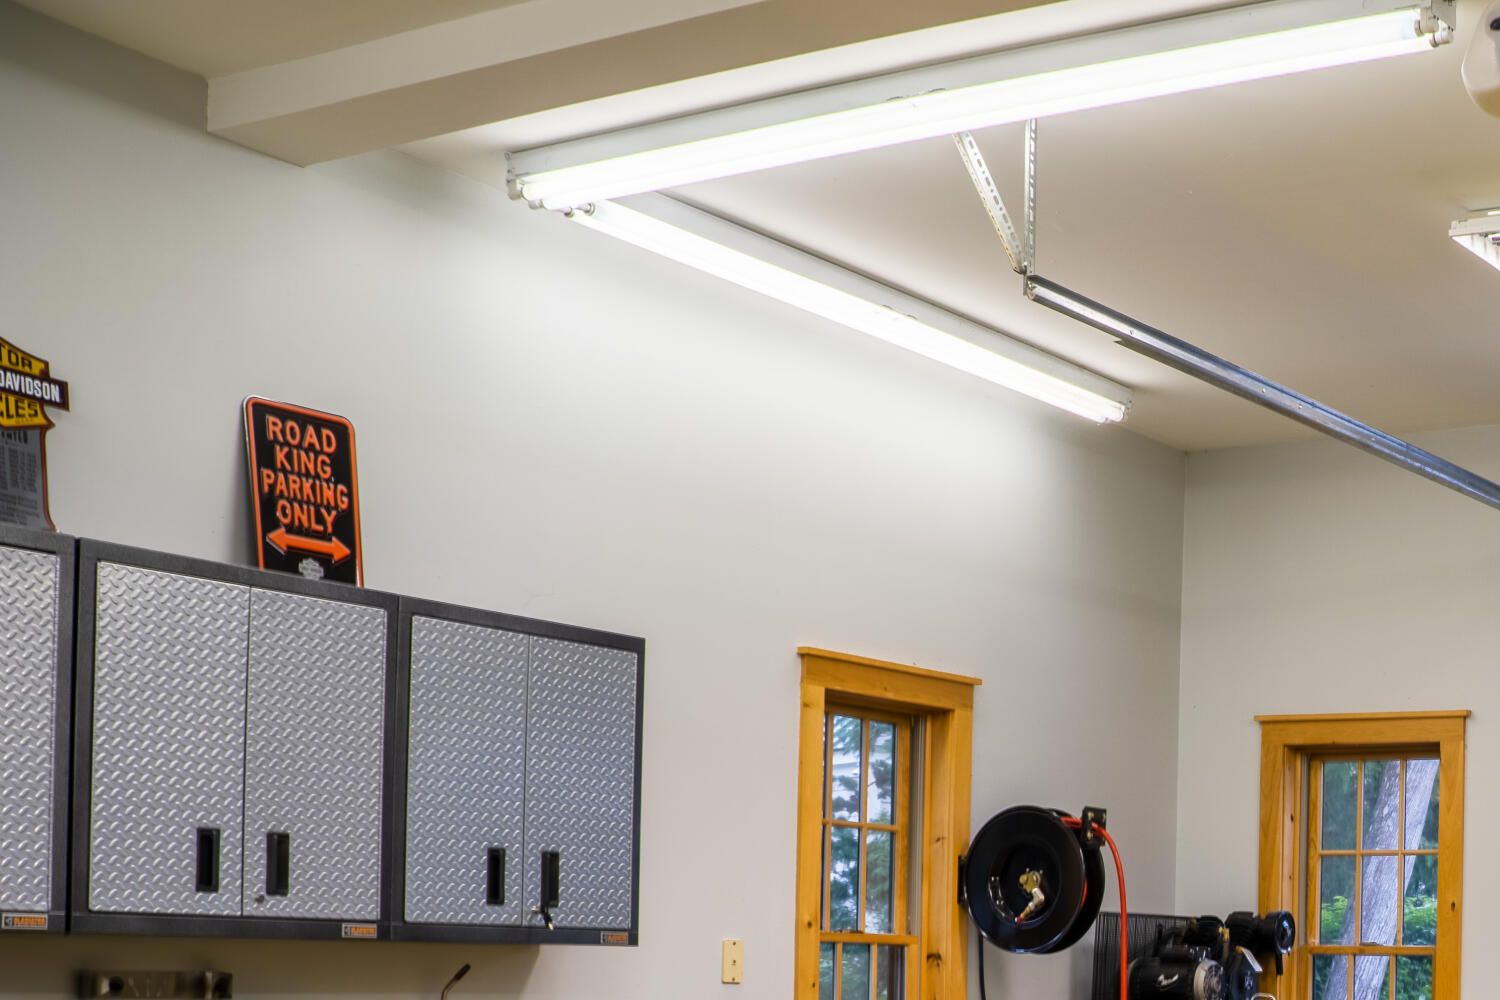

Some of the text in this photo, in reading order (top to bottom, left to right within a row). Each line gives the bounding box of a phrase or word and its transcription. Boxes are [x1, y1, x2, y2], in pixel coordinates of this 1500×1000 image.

[266, 415, 337, 454] ROAD
[275, 444, 332, 479] KING
[261, 468, 349, 511] PARKING
[277, 499, 337, 534] ONLY
